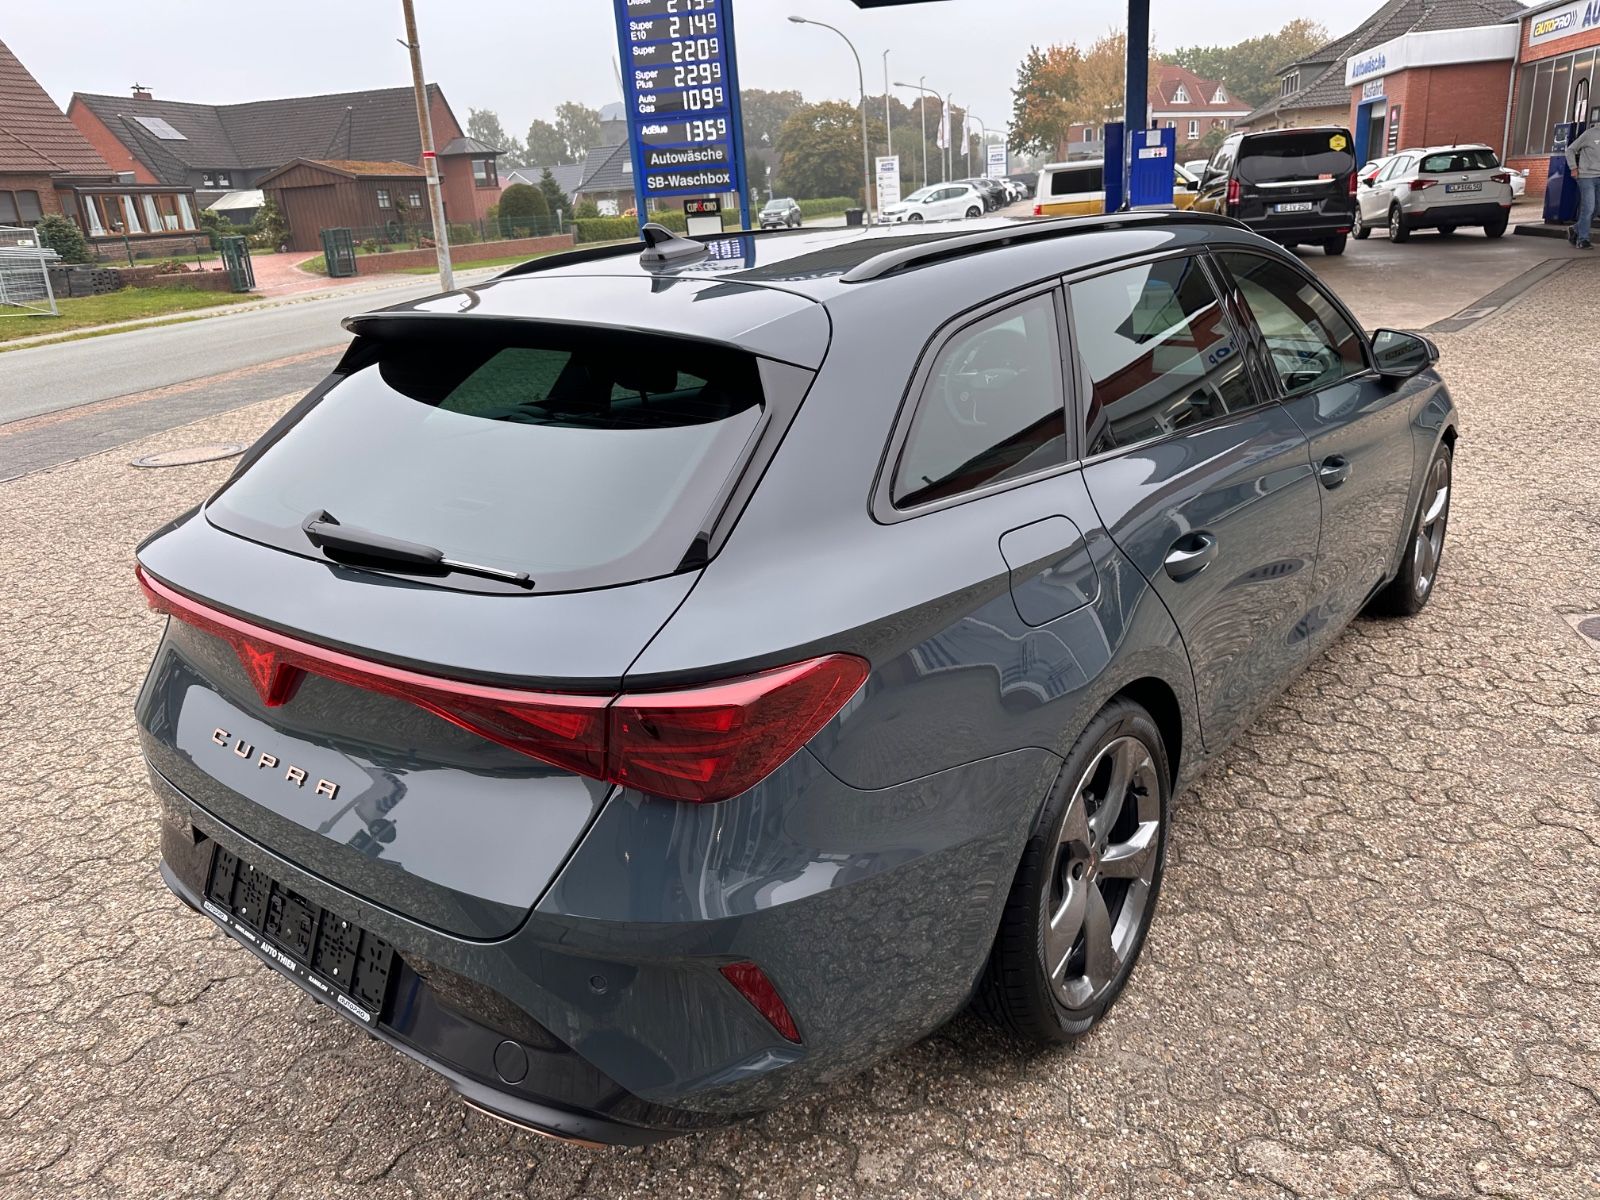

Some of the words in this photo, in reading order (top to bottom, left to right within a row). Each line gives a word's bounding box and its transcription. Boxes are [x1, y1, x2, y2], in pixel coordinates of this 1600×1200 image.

[630, 21, 653, 30] Super
[631, 31, 647, 40] E10
[632, 46, 656, 56] Super
[635, 70, 658, 80] Super
[636, 80, 653, 89] Plus
[638, 95, 656, 103] Auto
[639, 104, 655, 113] Gas
[642, 125, 668, 135] AdBlue
[650, 148, 723, 165] Autowäsche
[647, 173, 730, 189] SB-Waschbox
[212, 727, 340, 800] CUPRA
[261, 942, 278, 958] AUTO
[276, 953, 297, 971] THIEN
